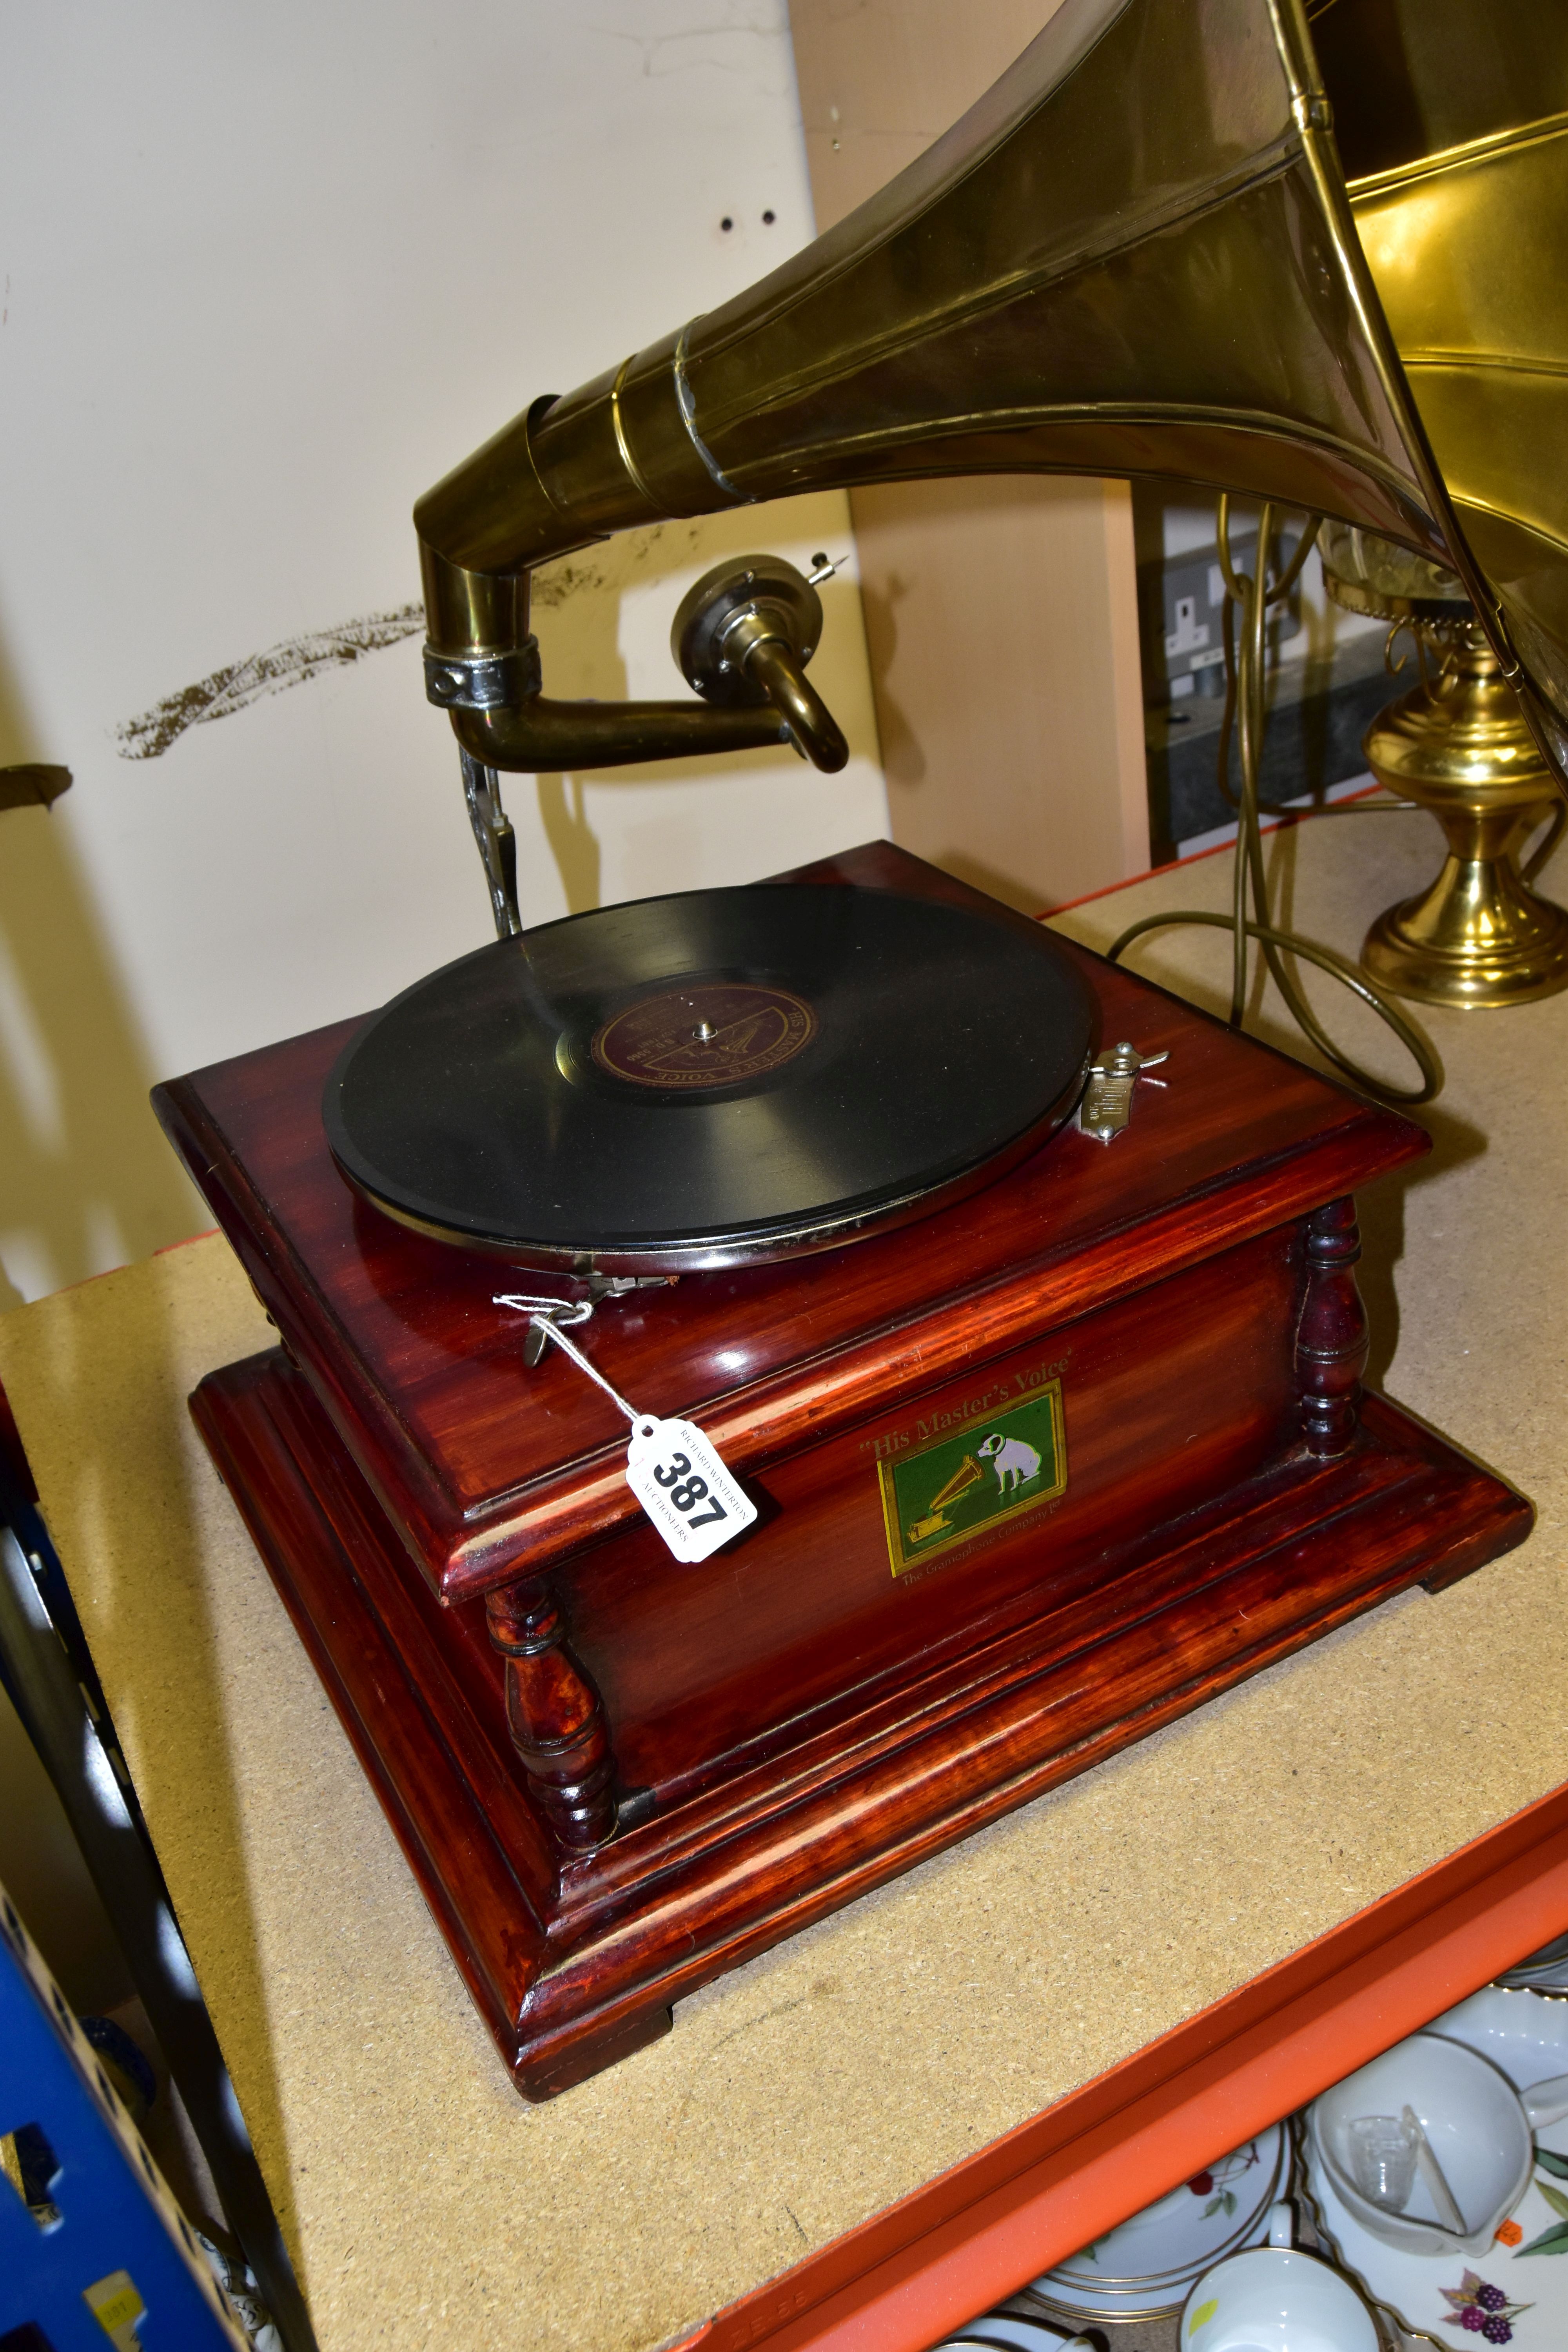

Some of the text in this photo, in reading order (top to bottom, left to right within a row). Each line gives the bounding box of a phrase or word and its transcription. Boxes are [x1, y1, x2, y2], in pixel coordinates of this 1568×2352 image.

[916, 1385, 1009, 1440] Master's
[653, 1452, 728, 1530] 387
[680, 1429, 748, 1520] RICHARD WINTERTON
[642, 1482, 689, 1543] AUCTIONEERS
[998, 1510, 1047, 1539] Company
